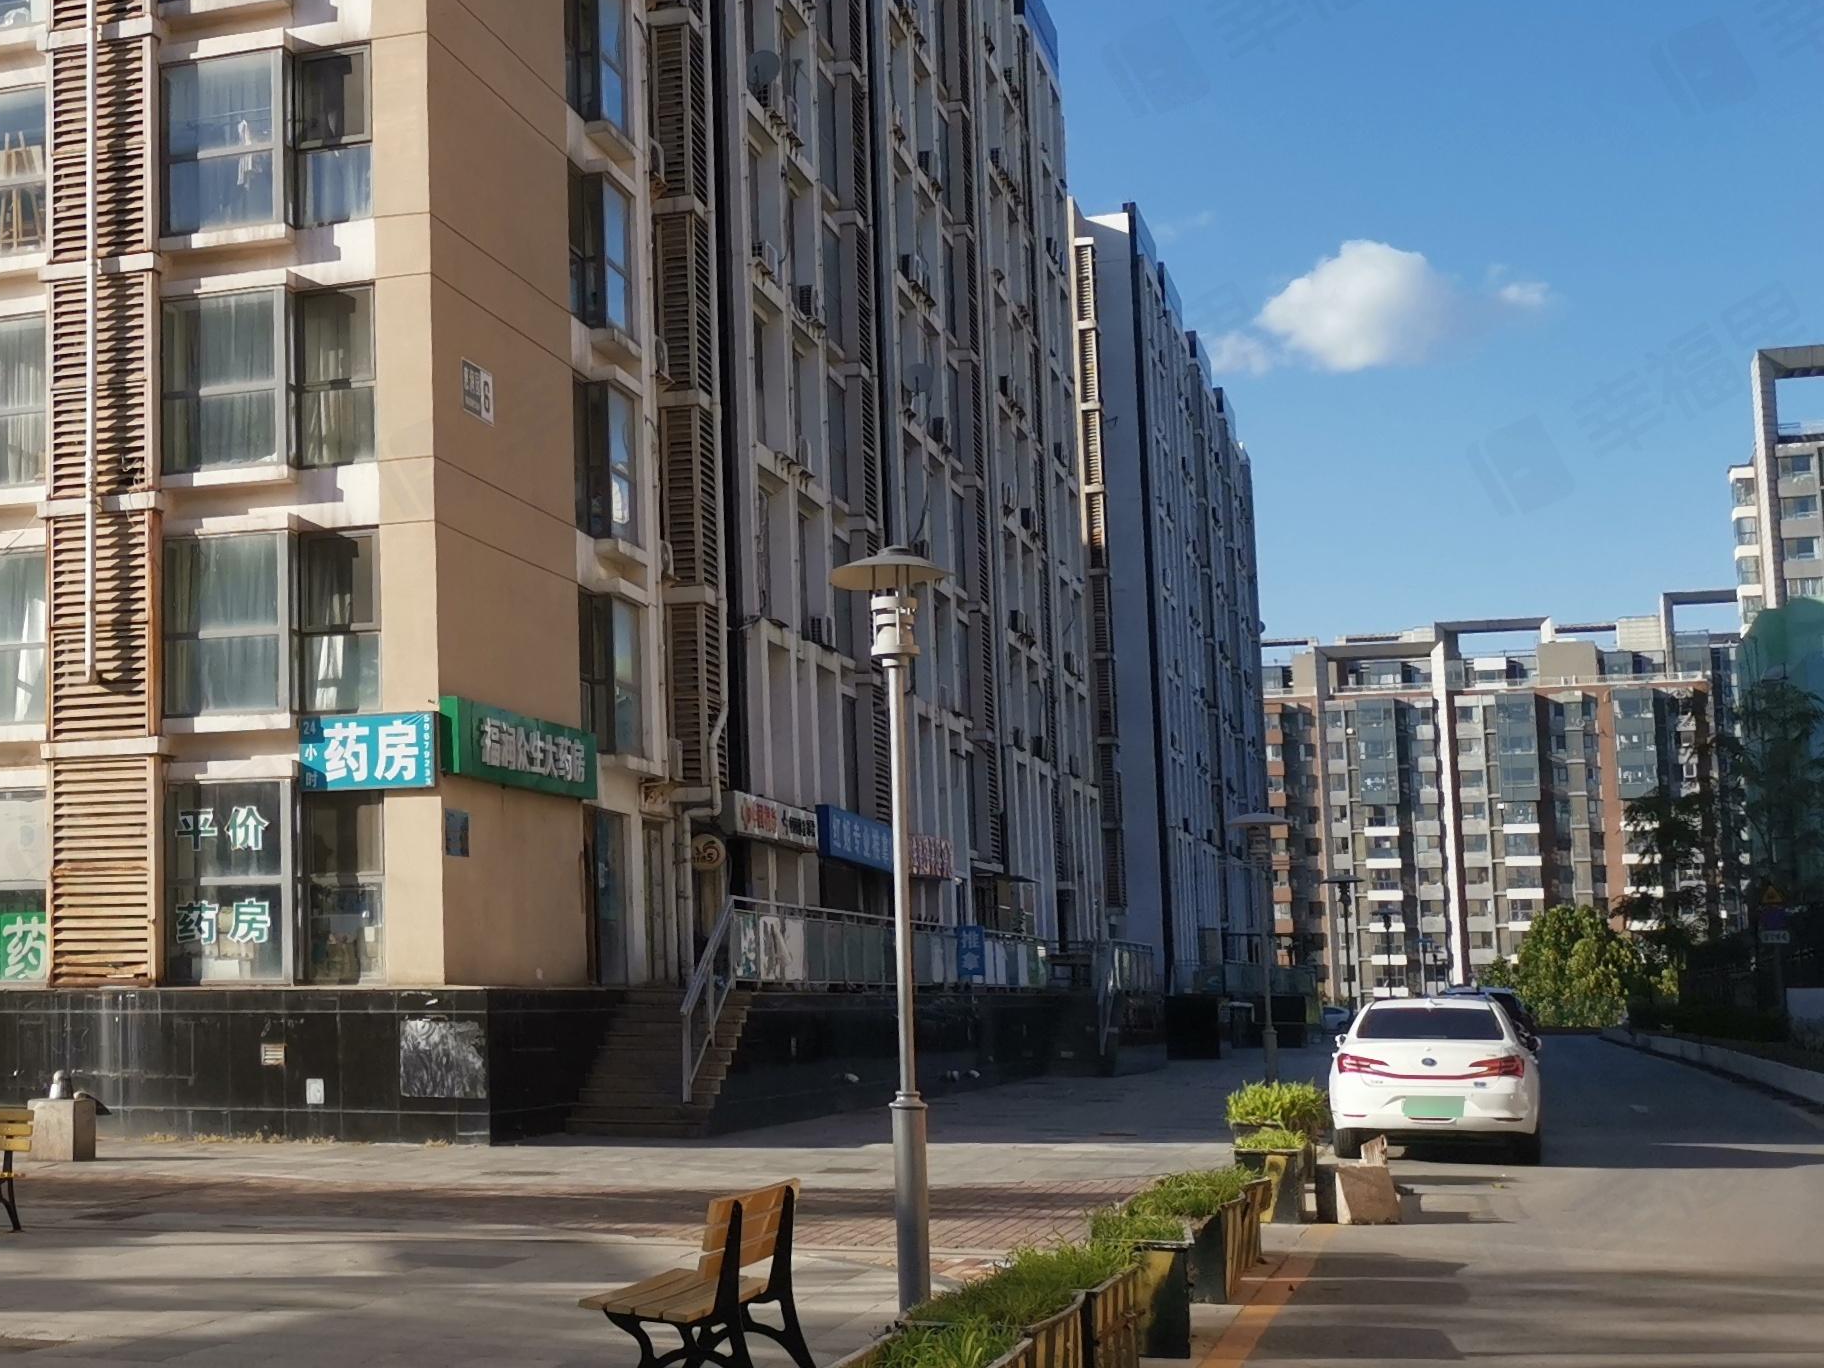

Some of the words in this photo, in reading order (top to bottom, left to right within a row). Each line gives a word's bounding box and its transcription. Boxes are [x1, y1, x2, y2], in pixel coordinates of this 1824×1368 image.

[323, 720, 419, 782] 药房
[175, 805, 271, 852] 平价
[175, 896, 271, 946] 药房
